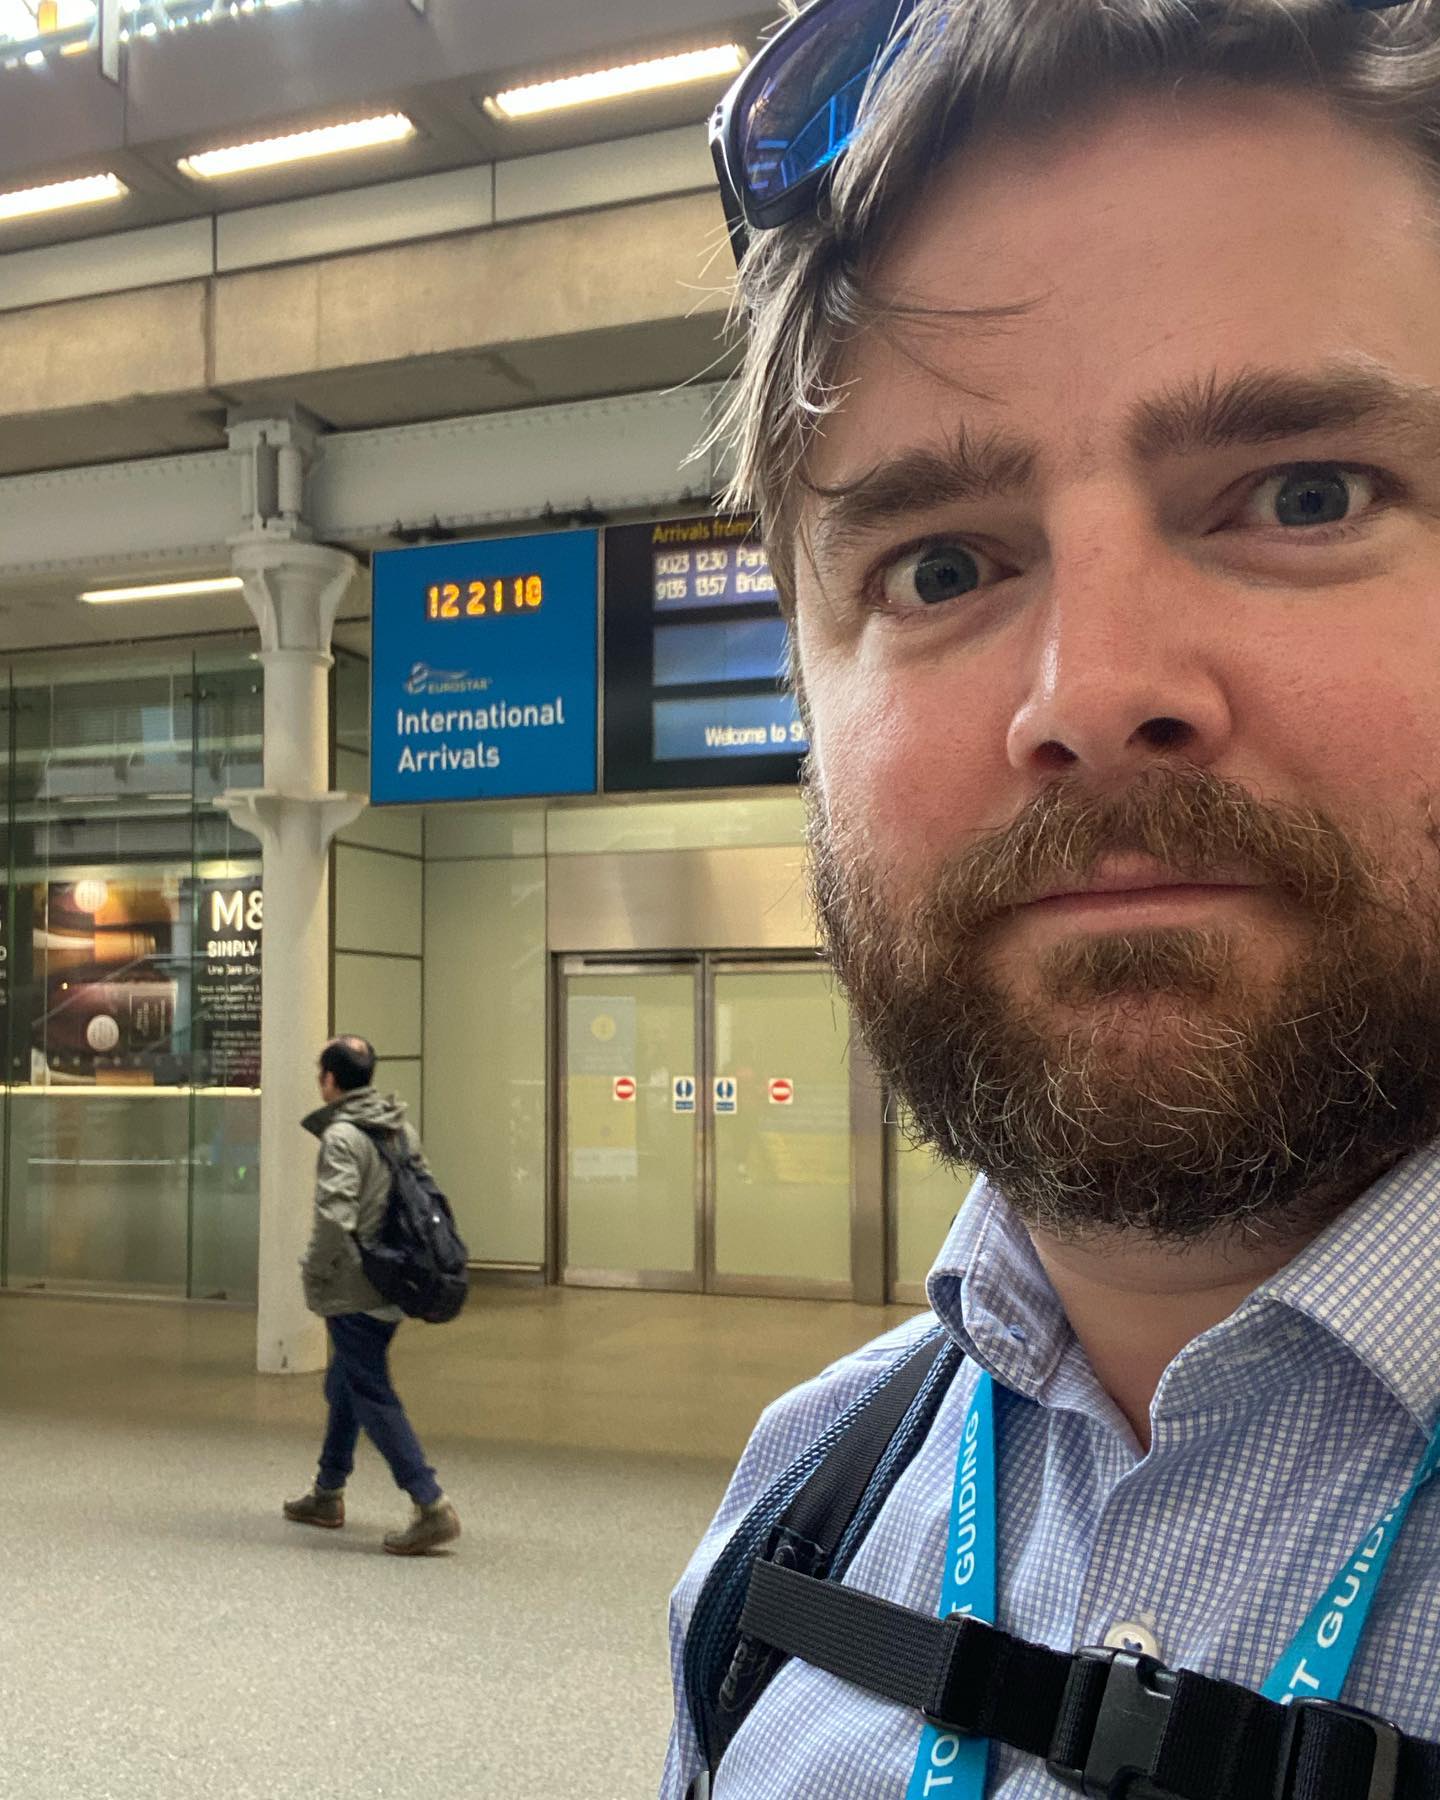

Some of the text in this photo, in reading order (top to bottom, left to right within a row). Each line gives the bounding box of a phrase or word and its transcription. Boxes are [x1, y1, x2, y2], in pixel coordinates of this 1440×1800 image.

[652, 520, 710, 544] Arrivals
[428, 678, 489, 694] EUROSTAR
[397, 696, 565, 736] International
[705, 725, 767, 747] Welcome
[770, 720, 787, 743] to
[397, 741, 500, 774] Arrivals
[211, 890, 263, 932] M&
[207, 940, 258, 957] SIMPLY
[954, 1410, 980, 1586] GUIDING
